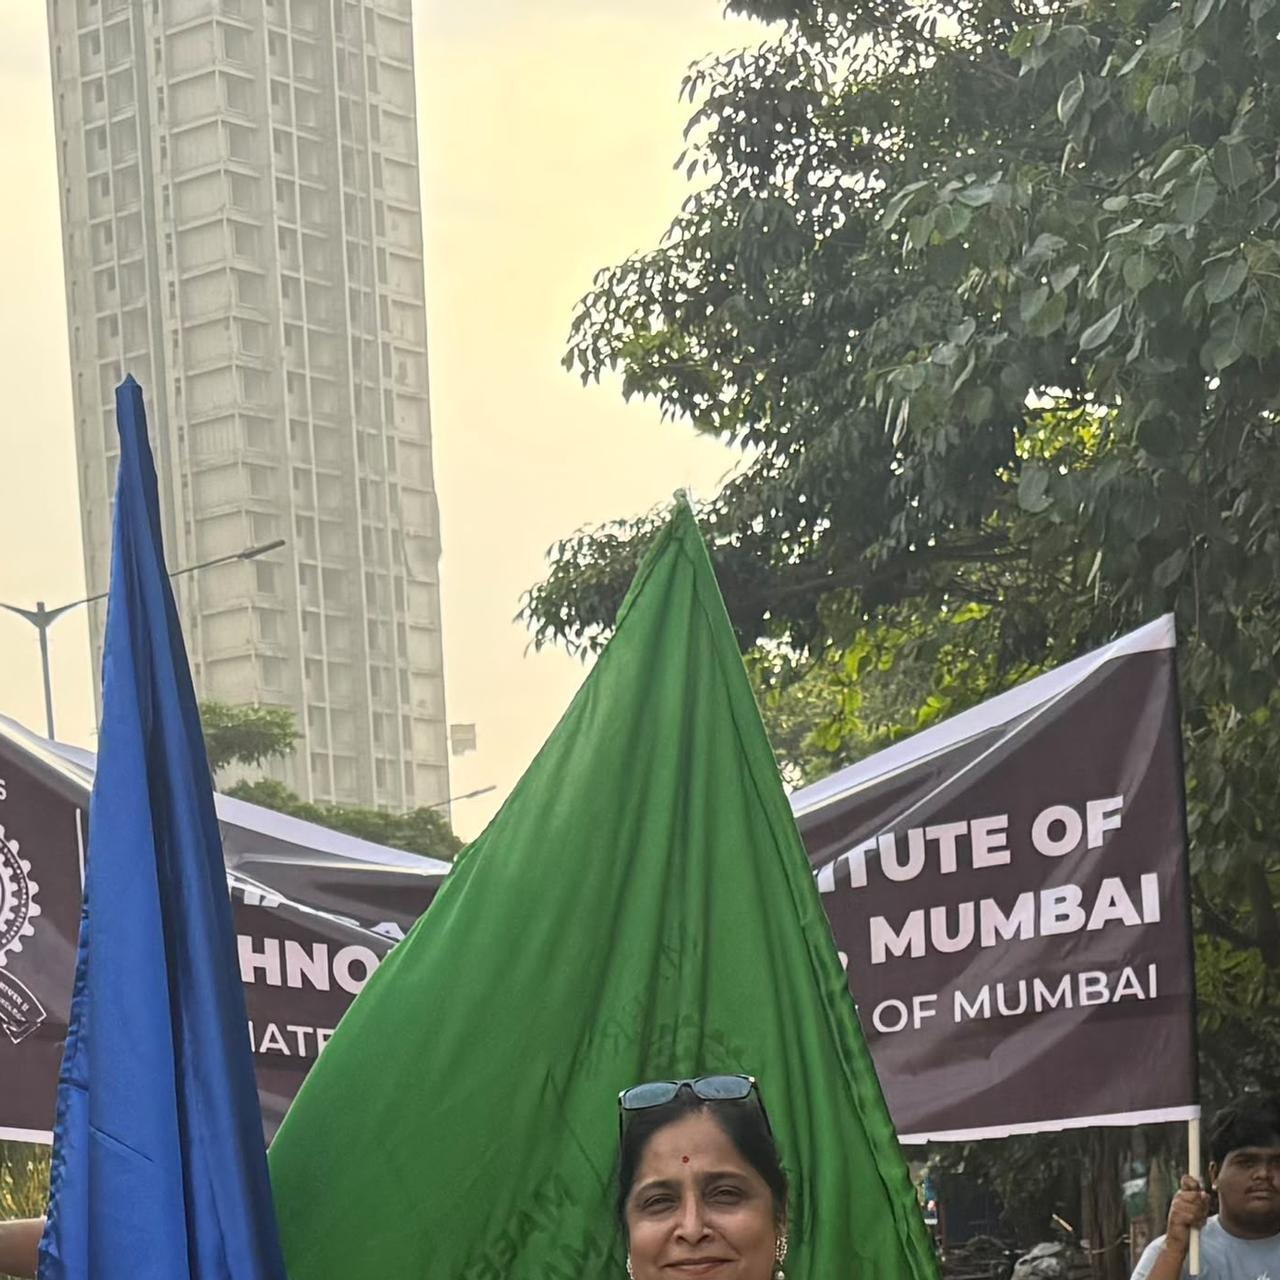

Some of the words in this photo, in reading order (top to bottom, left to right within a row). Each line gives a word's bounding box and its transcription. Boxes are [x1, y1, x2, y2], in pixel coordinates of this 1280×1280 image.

[814, 814, 1011, 893] ITUTE
[1031, 795, 1124, 857] OF
[237, 934, 382, 995] HNO
[869, 872, 1161, 965] MUMBAI
[872, 993, 938, 1033] OF
[953, 963, 1158, 1023] MUMBAI
